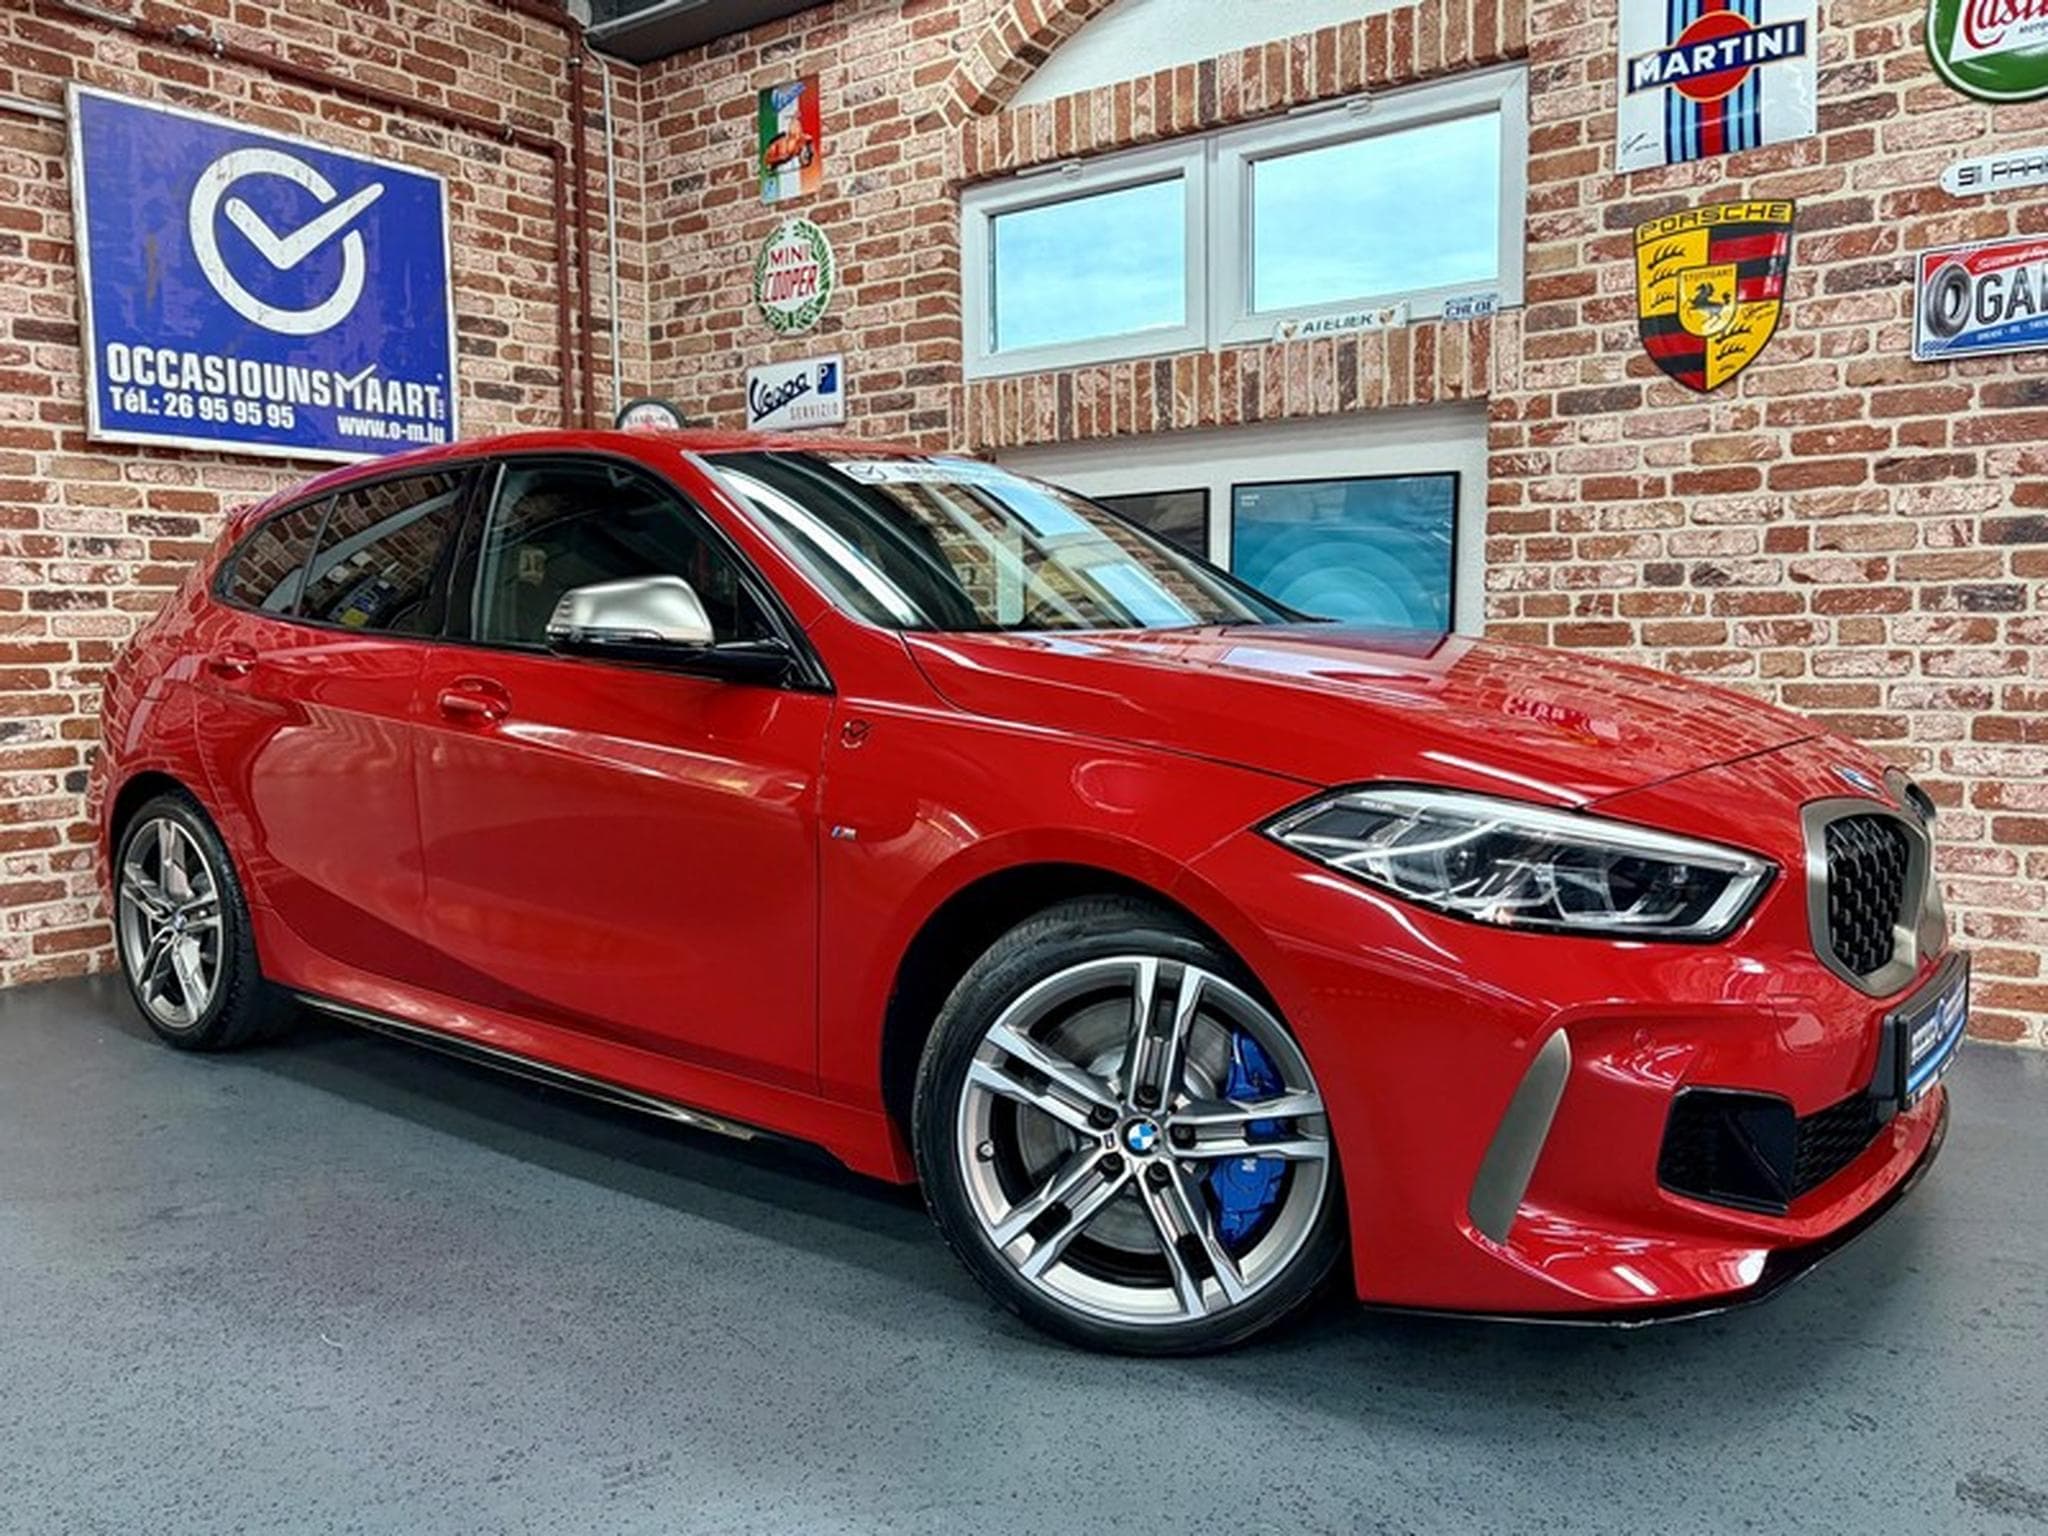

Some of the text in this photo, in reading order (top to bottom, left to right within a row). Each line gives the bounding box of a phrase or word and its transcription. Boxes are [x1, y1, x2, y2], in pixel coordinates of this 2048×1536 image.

[1634, 25, 1797, 87] MARTINI
[1640, 204, 1787, 240] PORSCHE
[770, 245, 810, 268] MINI
[763, 265, 817, 302] COOPER
[109, 385, 295, 430] Tél.: 26 95 95 95
[751, 372, 812, 423] Vespa
[337, 415, 446, 444] www.o-m.lu
